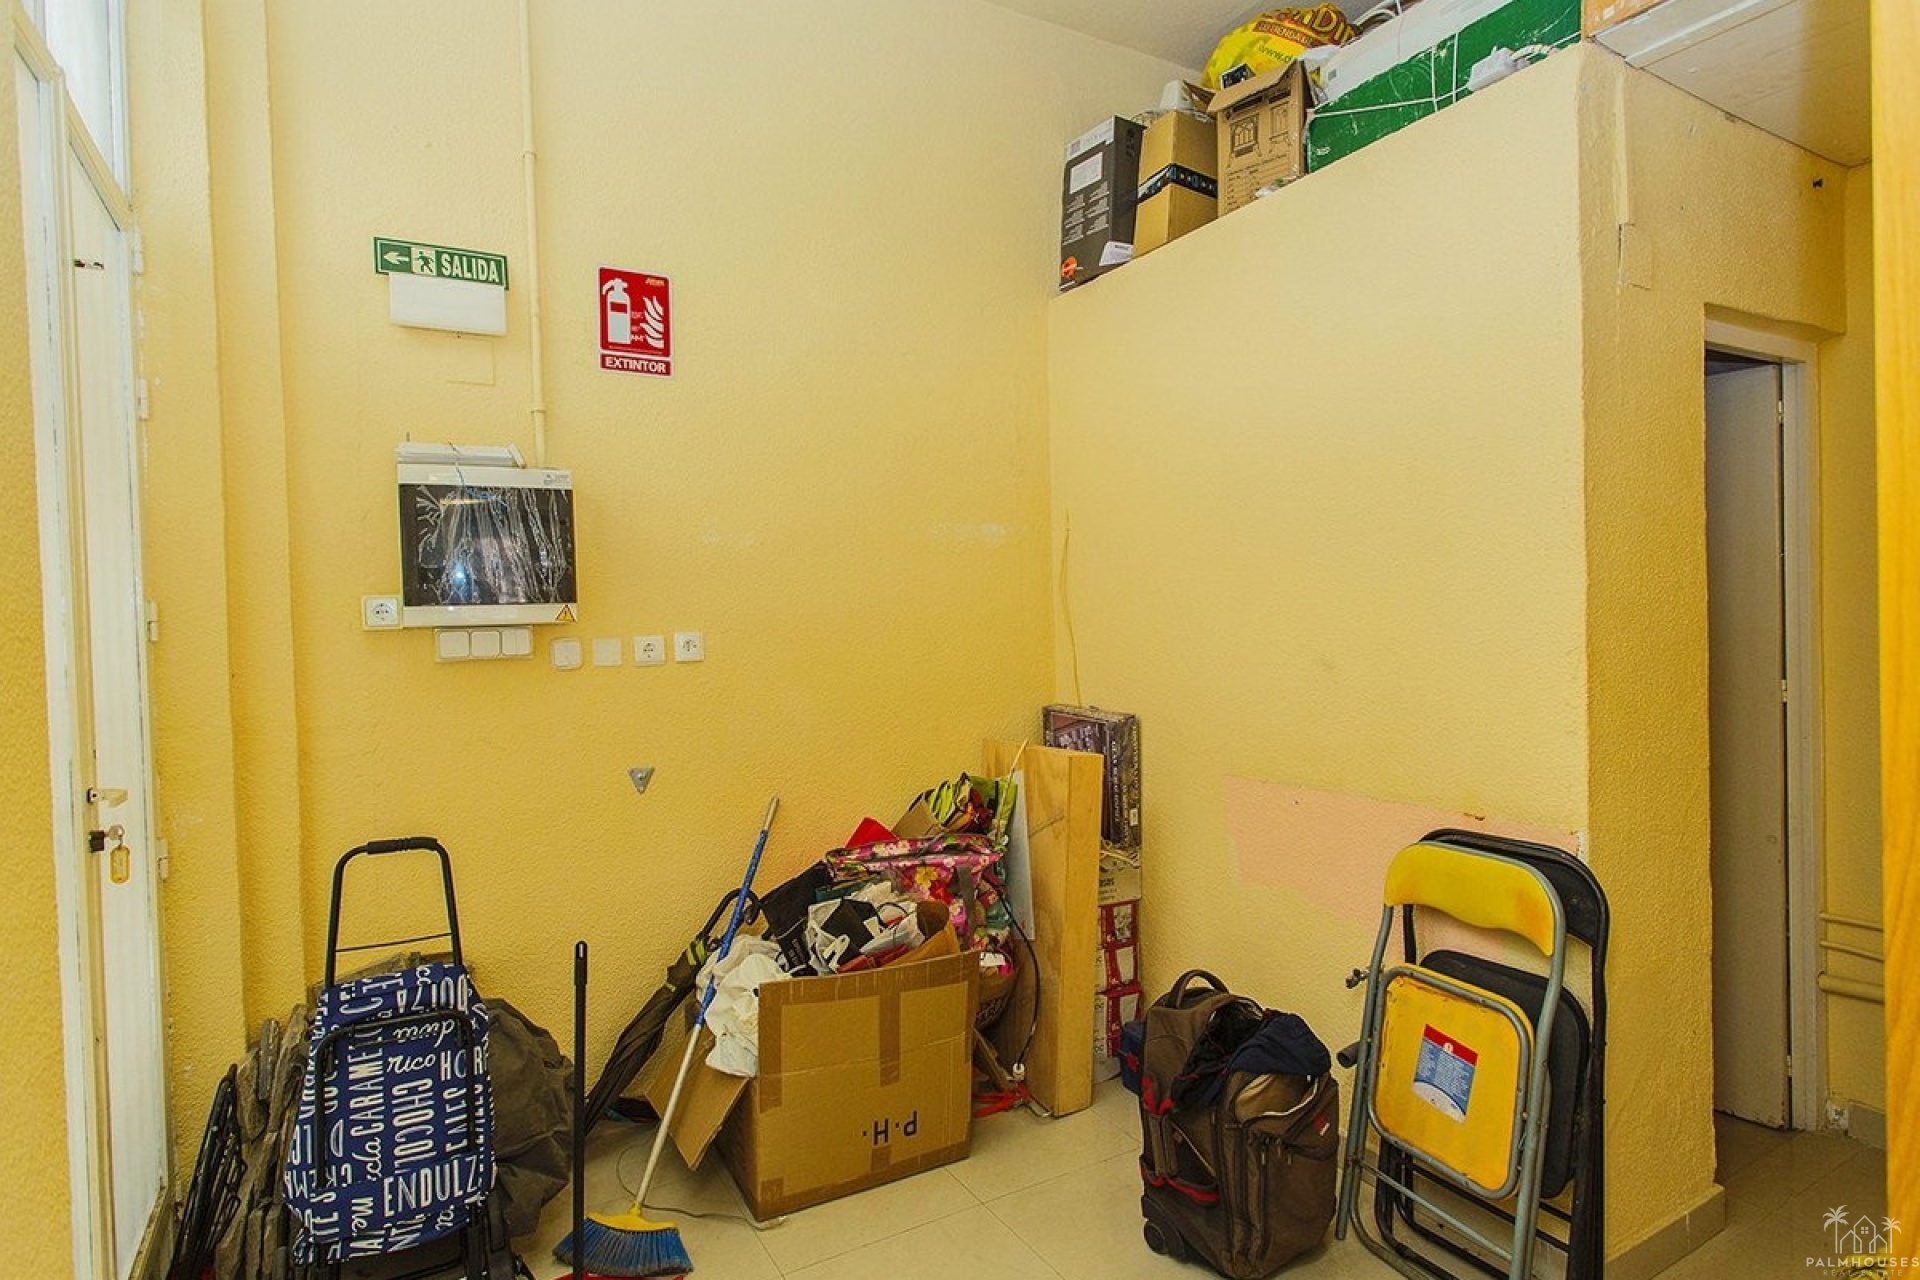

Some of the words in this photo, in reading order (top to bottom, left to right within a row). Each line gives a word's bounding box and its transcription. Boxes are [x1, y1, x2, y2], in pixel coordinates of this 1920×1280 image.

[440, 253, 500, 283] SALIDA
[605, 356, 667, 374] EXTINTOR
[386, 1053, 436, 1075] rico
[391, 1078, 438, 1175] CHOCOL
